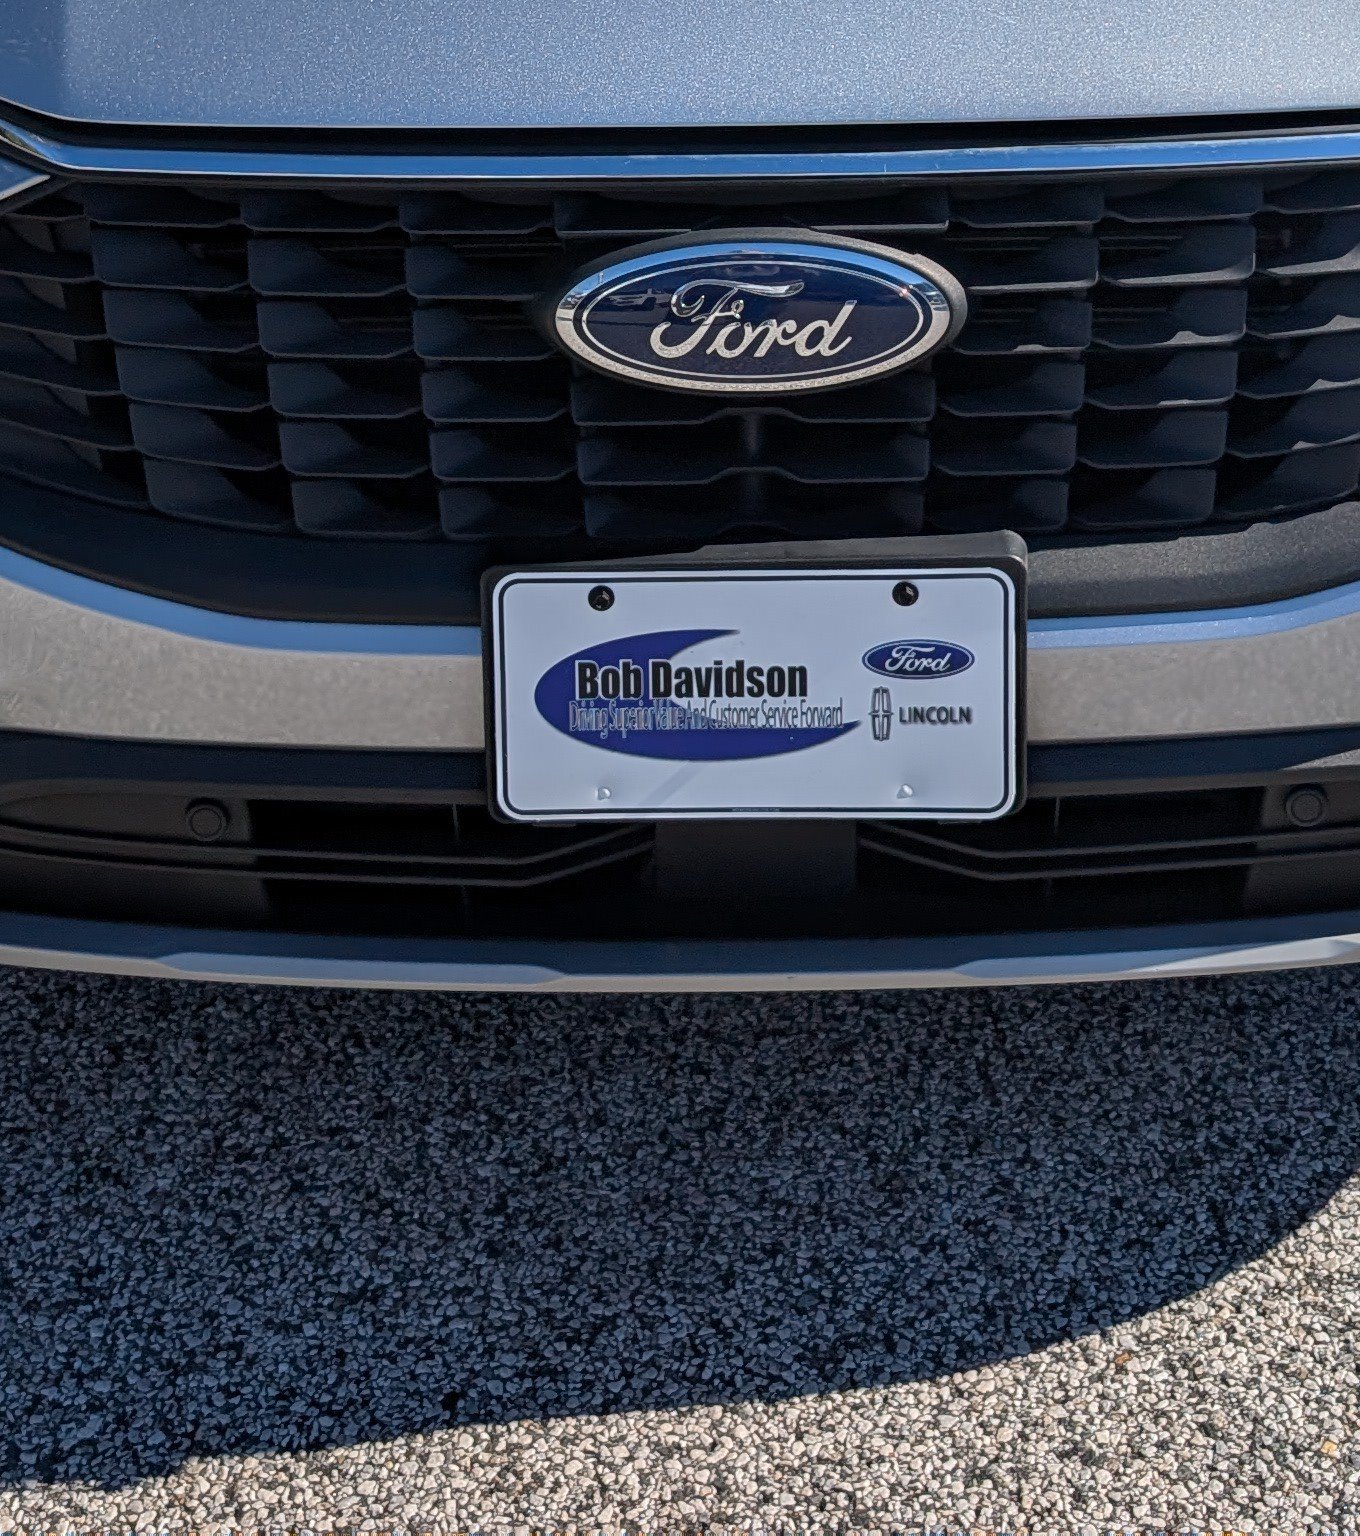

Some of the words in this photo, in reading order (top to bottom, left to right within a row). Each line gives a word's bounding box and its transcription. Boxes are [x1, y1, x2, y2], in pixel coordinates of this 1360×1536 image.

[648, 277, 858, 359] Ford
[884, 644, 952, 672] Ford
[575, 658, 644, 701] Bob
[648, 658, 809, 700] Davidson
[568, 699, 609, 739] Driving
[608, 698, 654, 739] Superior
[652, 698, 685, 732] Value
[685, 698, 709, 731] And
[709, 698, 760, 730] Customer
[760, 698, 800, 730] Service
[800, 697, 845, 730] Forward
[898, 705, 973, 725] LINCOLN
